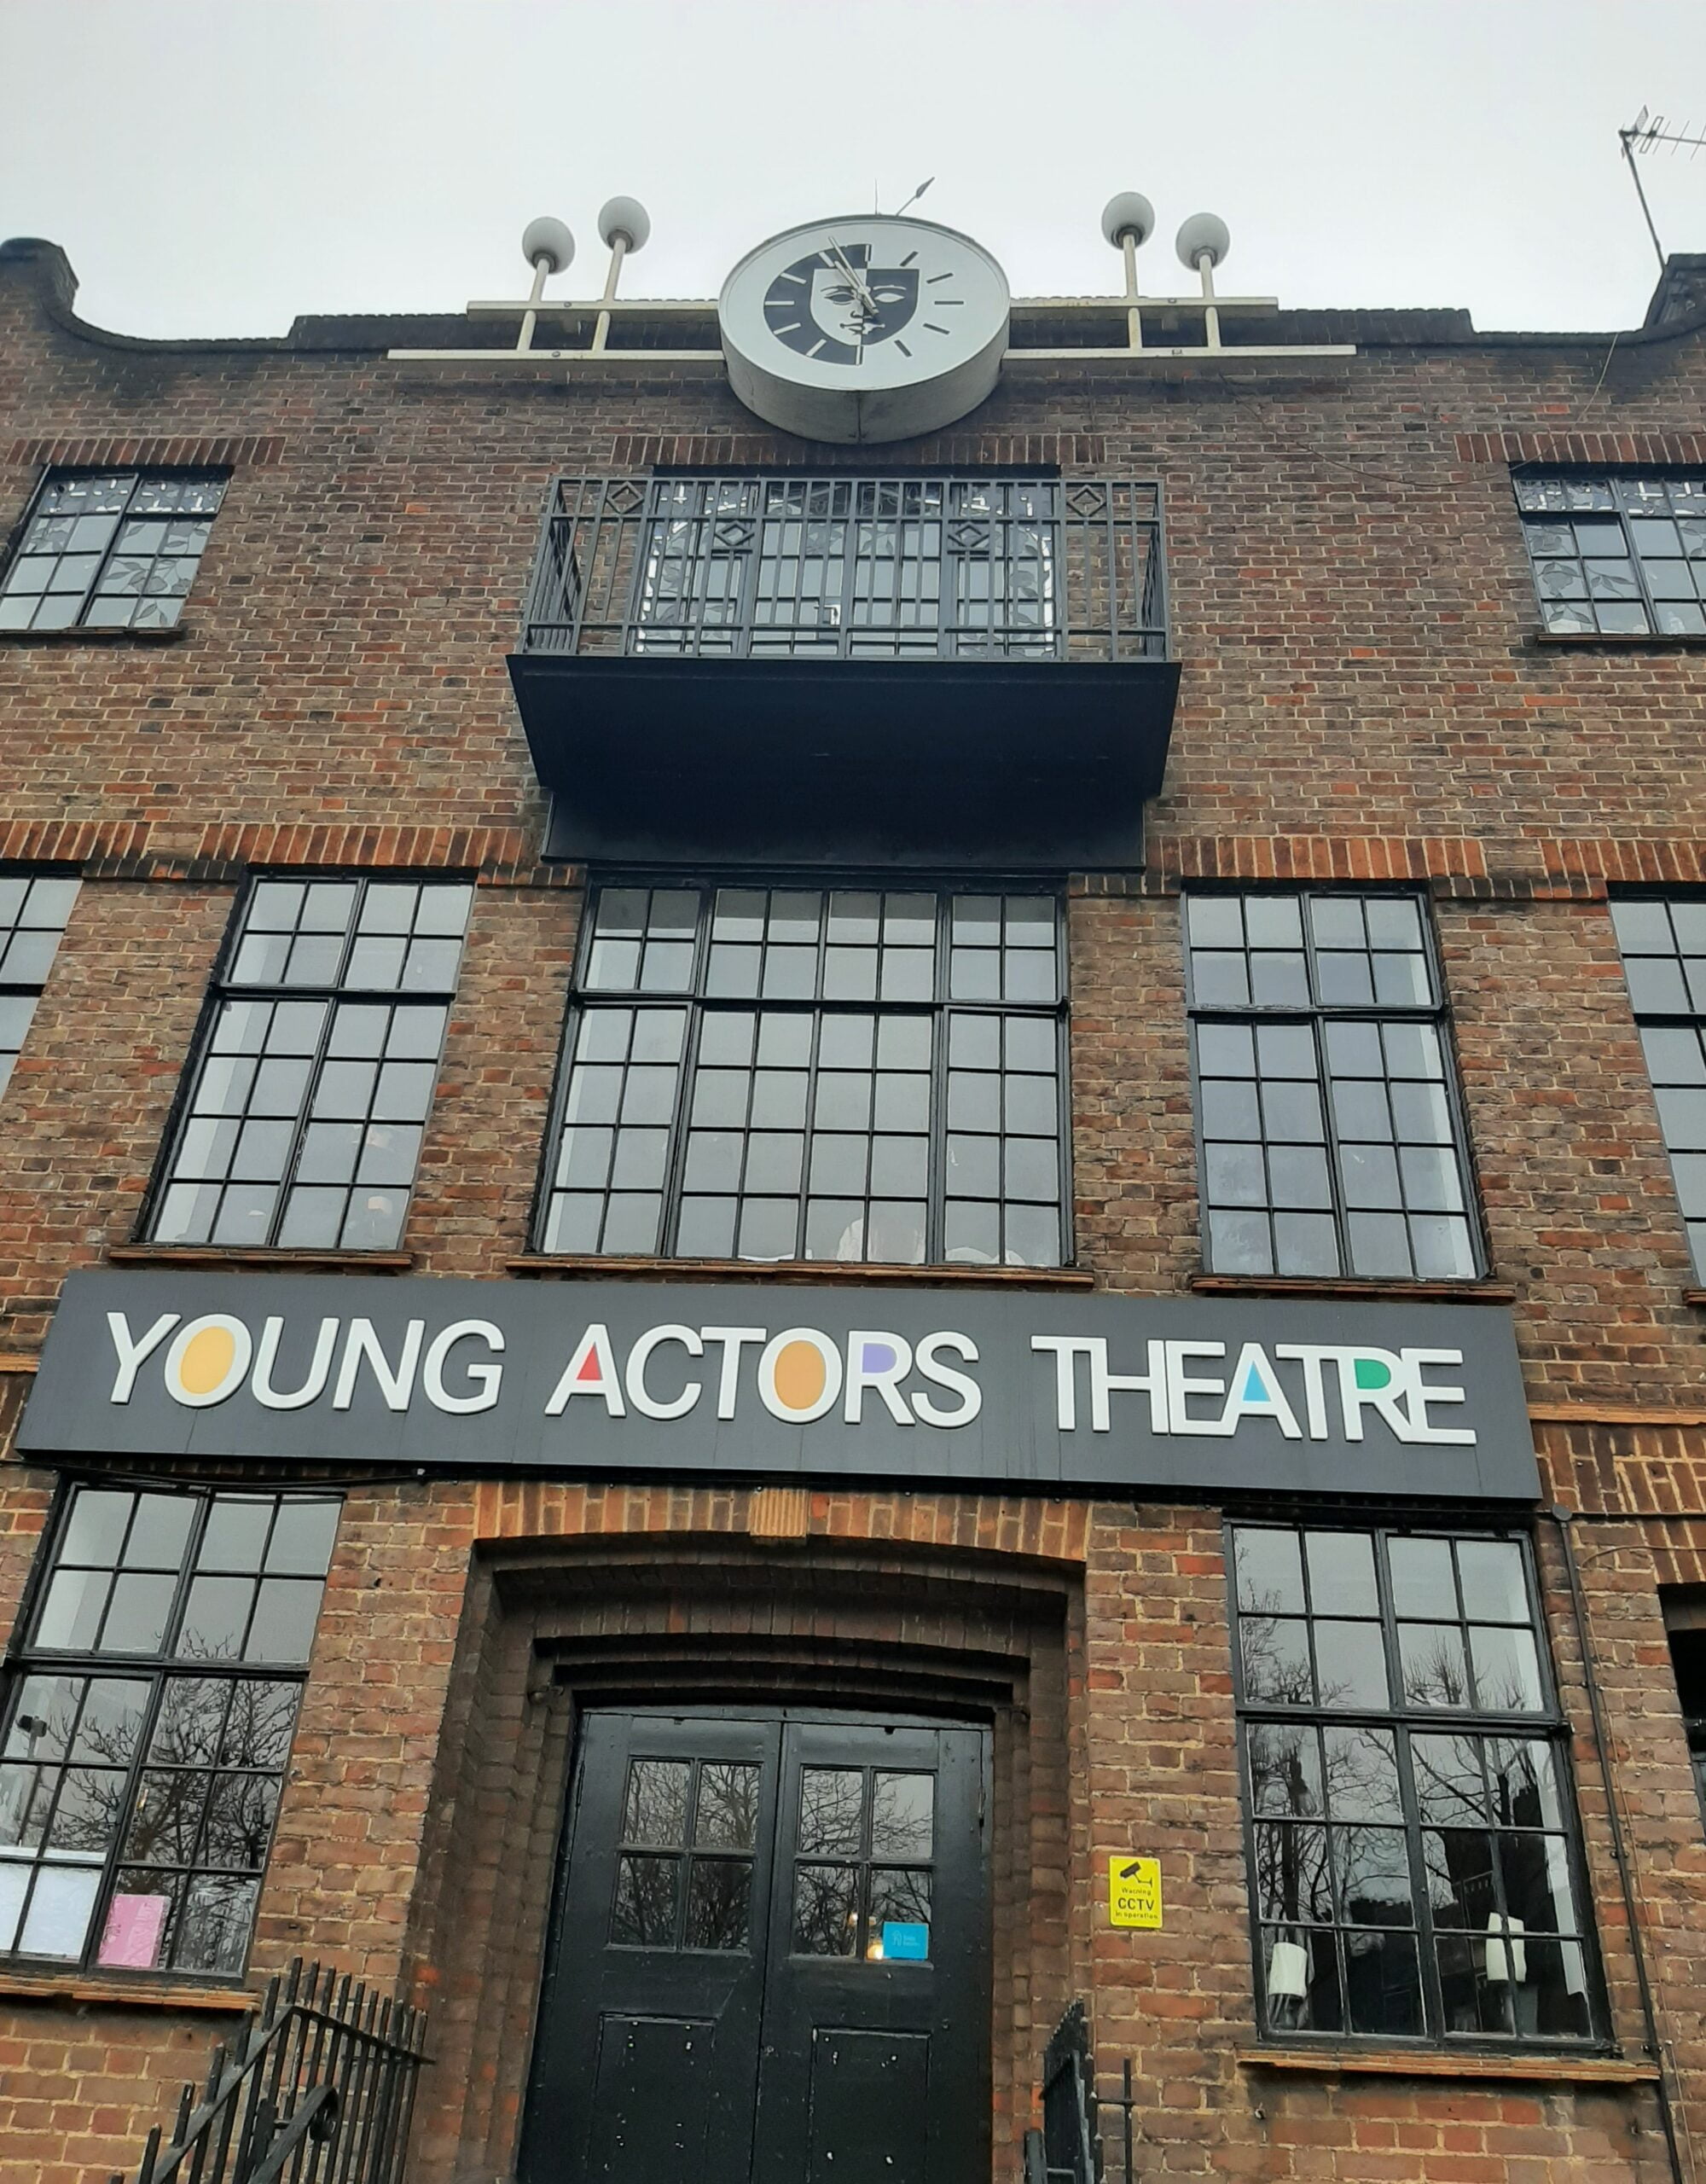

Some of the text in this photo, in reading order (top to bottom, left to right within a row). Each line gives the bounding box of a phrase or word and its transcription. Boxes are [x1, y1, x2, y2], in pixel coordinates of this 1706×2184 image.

[107, 1312, 1477, 1444] YOUNG ACTORS THEATRE
[1117, 1897, 1155, 1911] CCTV
